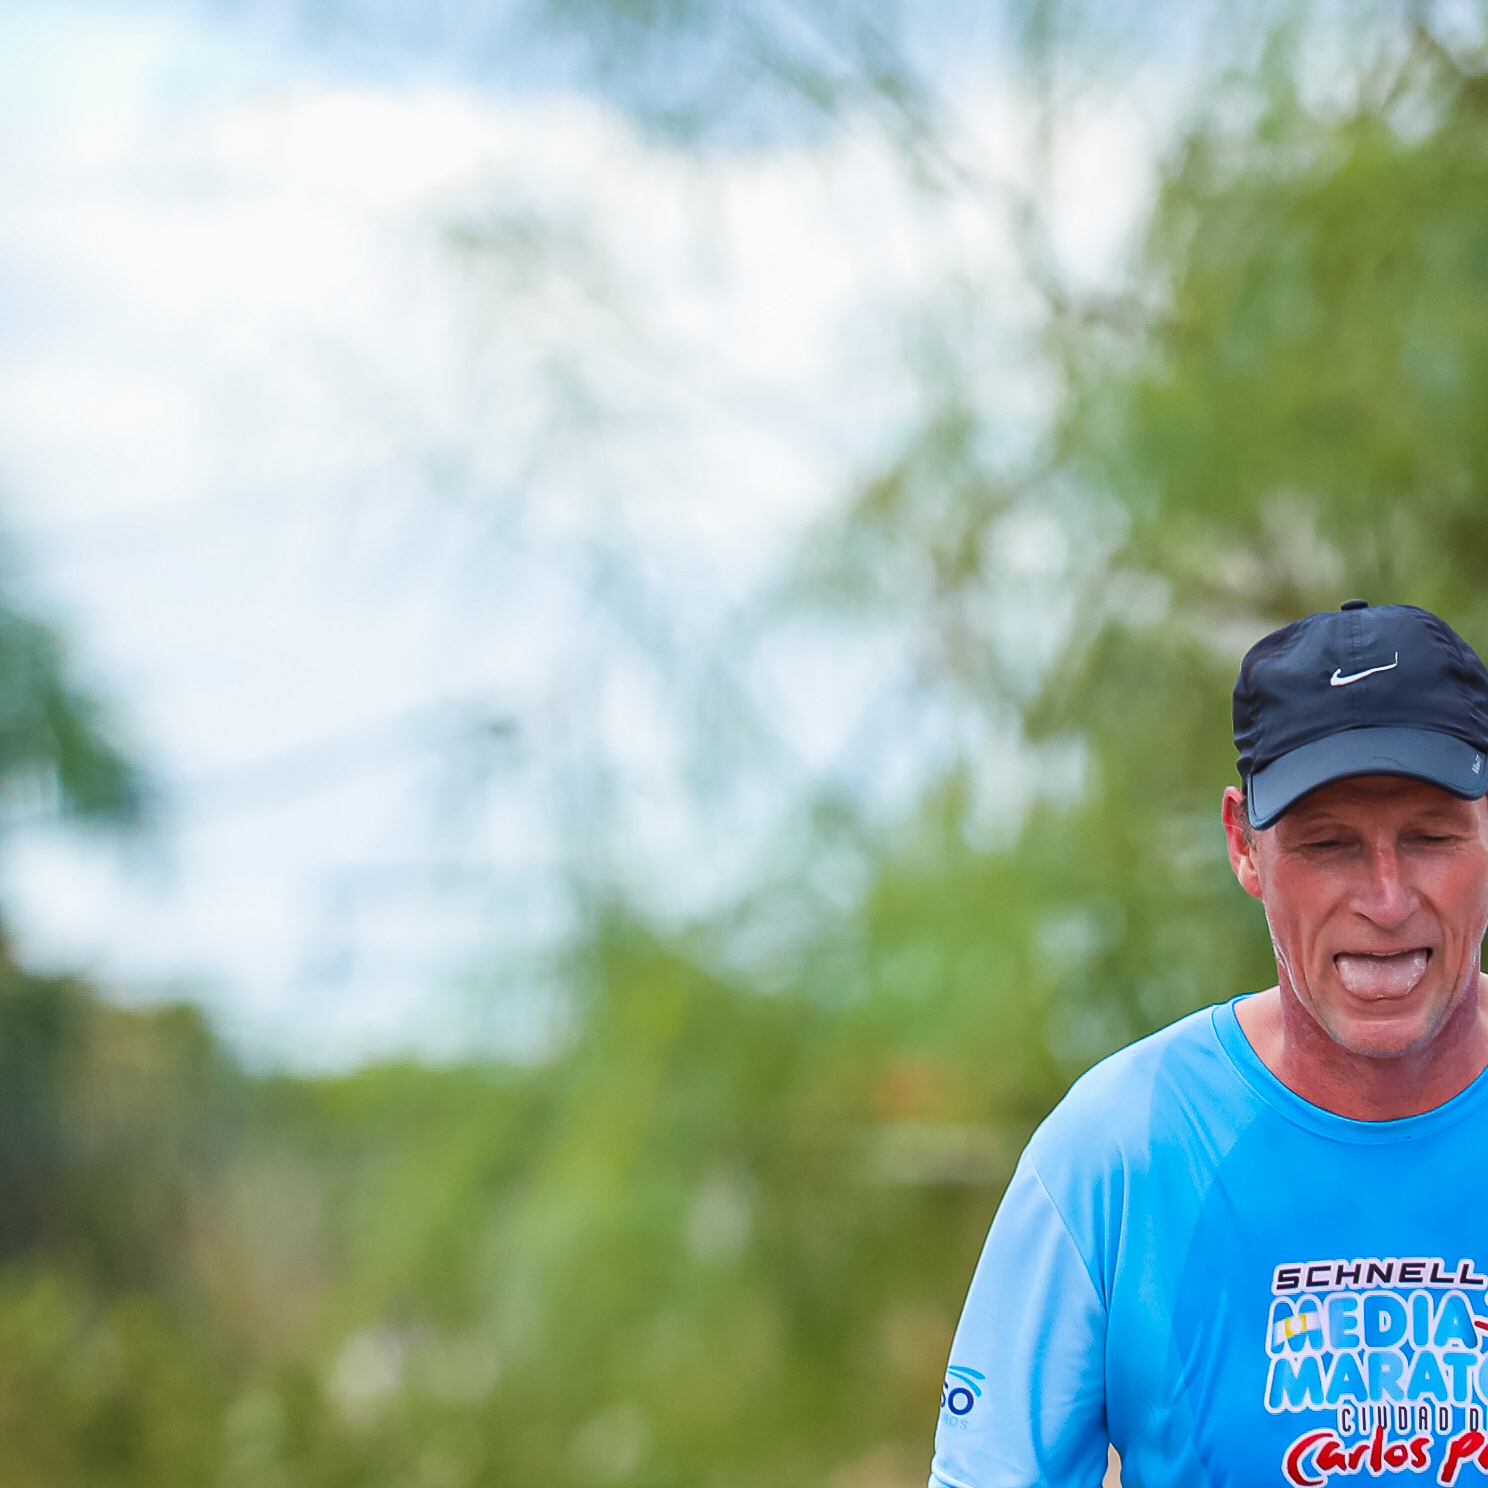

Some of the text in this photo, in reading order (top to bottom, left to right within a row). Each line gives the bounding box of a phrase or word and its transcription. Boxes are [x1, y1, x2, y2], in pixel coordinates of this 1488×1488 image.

[1275, 1261, 1485, 1291] SCHNELL
[1268, 1292, 1480, 1352] MEDIA
[1341, 1406, 1448, 1433] CIUDAD
[1285, 1424, 1431, 1486] Carlos
